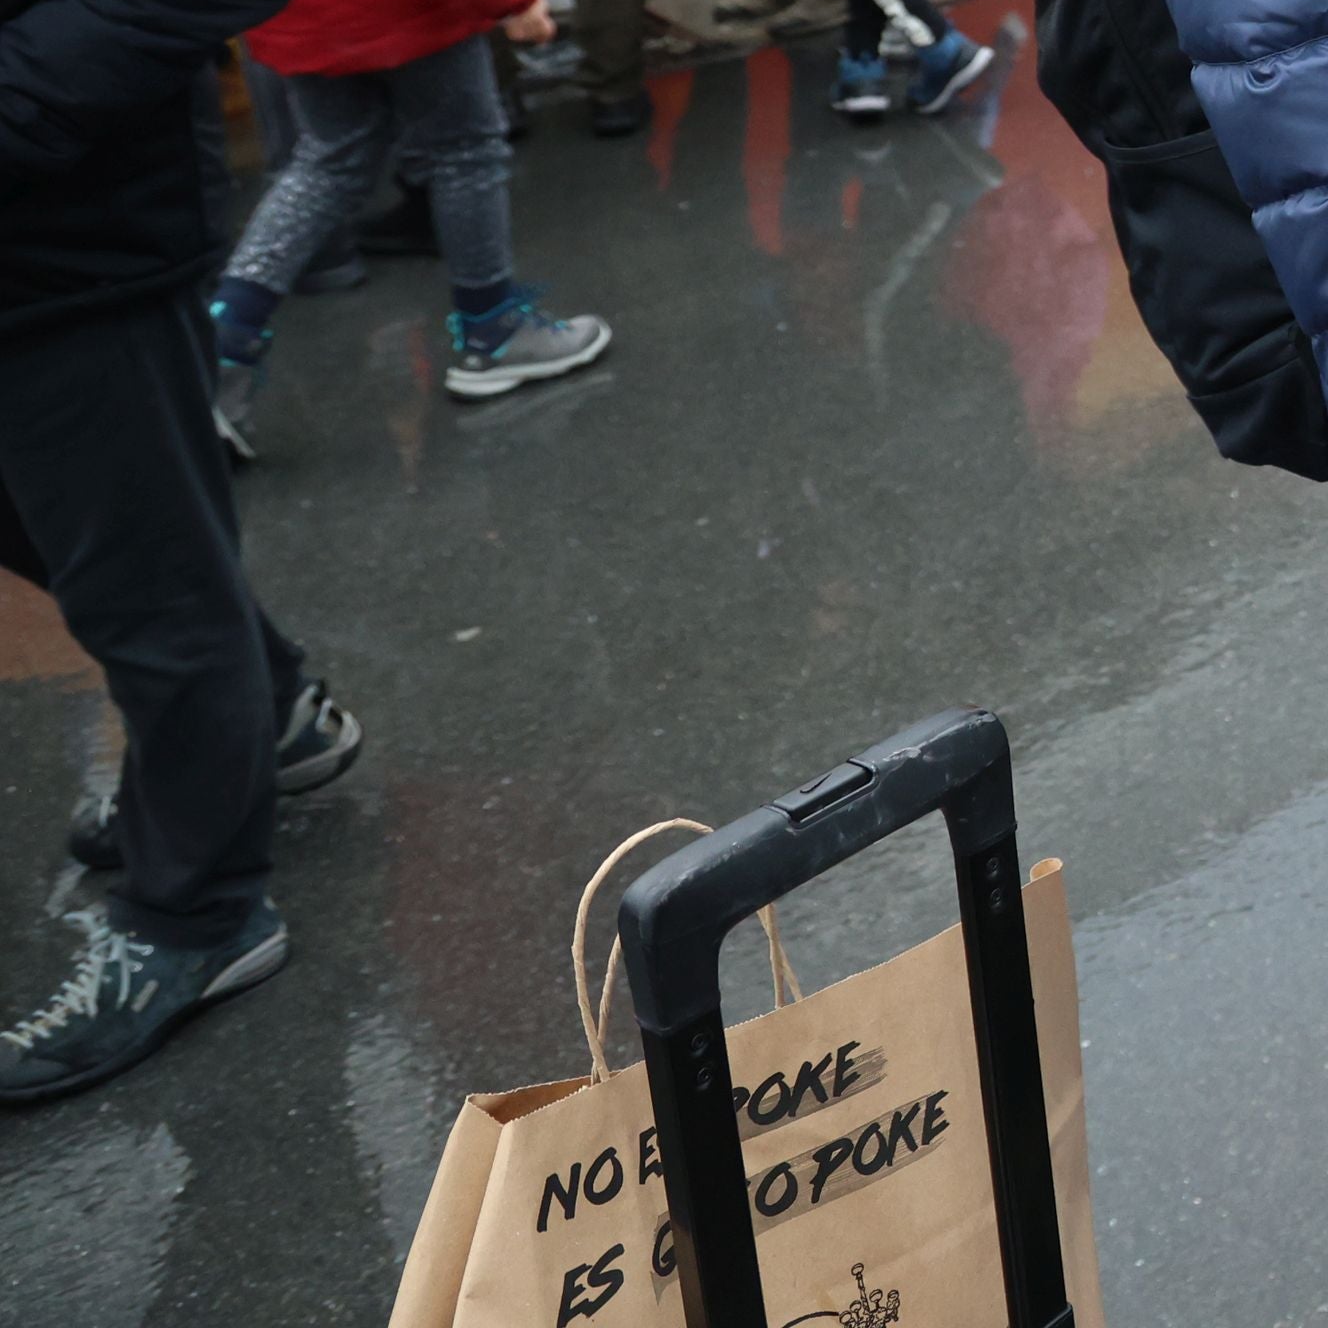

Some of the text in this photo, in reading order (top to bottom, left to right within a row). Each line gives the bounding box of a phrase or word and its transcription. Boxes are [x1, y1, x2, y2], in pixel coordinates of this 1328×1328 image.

[536, 1147, 624, 1233] NO
[556, 1243, 625, 1328] ES
[810, 1090, 951, 1205] POKE
